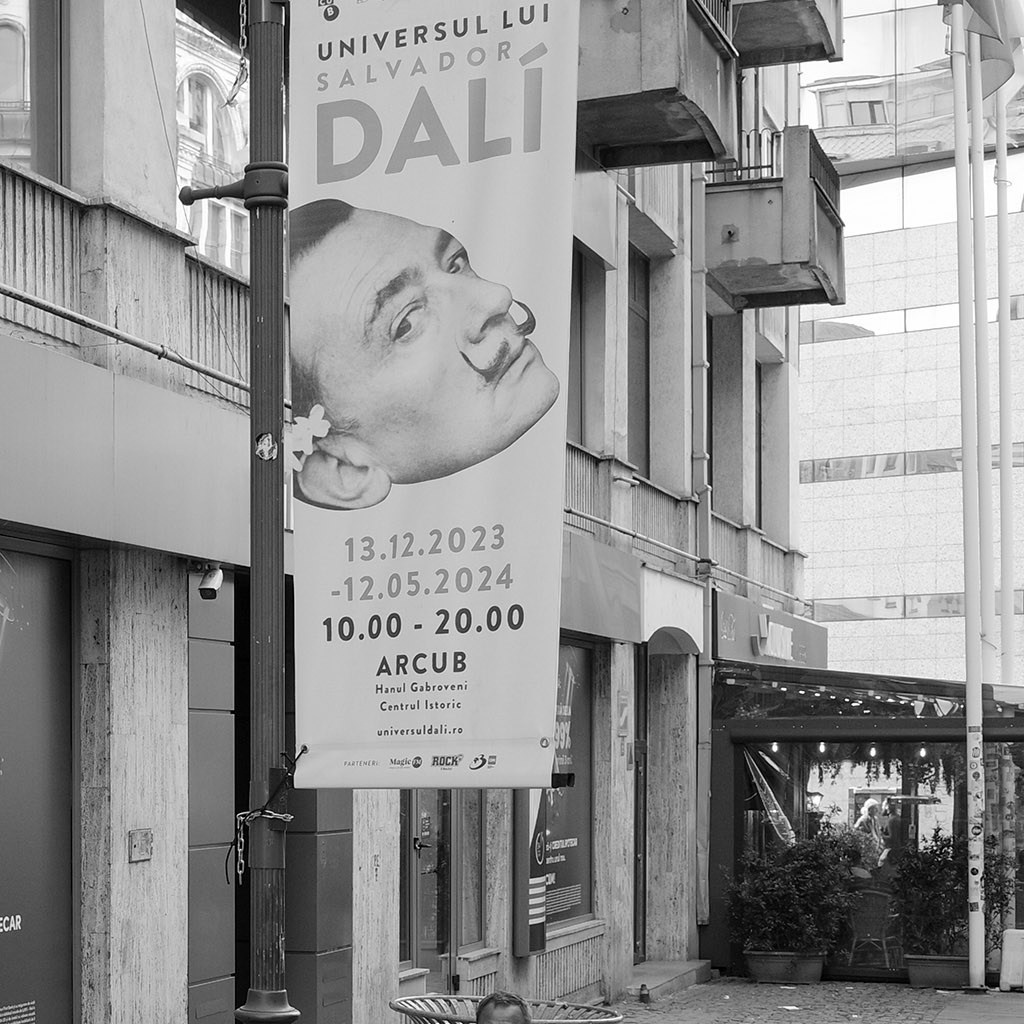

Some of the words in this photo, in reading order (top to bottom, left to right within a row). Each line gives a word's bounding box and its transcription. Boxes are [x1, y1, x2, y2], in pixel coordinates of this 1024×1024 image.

[318, 15, 488, 61] UNIVERSUL
[503, 3, 549, 29] LUI
[317, 41, 511, 91] SALVADOR
[316, 42, 548, 184] DALÍ
[344, 524, 504, 562] 13.12.2023
[331, 563, 513, 601] -12.05.2024
[322, 613, 401, 641] 10.00
[435, 604, 524, 634] 20.00
[376, 651, 467, 676] ARCUB
[376, 683, 406, 694] Hanul
[410, 681, 468, 693] Gabroveni
[380, 700, 420, 711] Centrul
[425, 699, 462, 710] Istoric
[377, 724, 463, 736] universuldali.ro
[554, 721, 571, 749] 99%
[389, 757, 411, 766] Magic
[432, 756, 458, 766] ROCK
